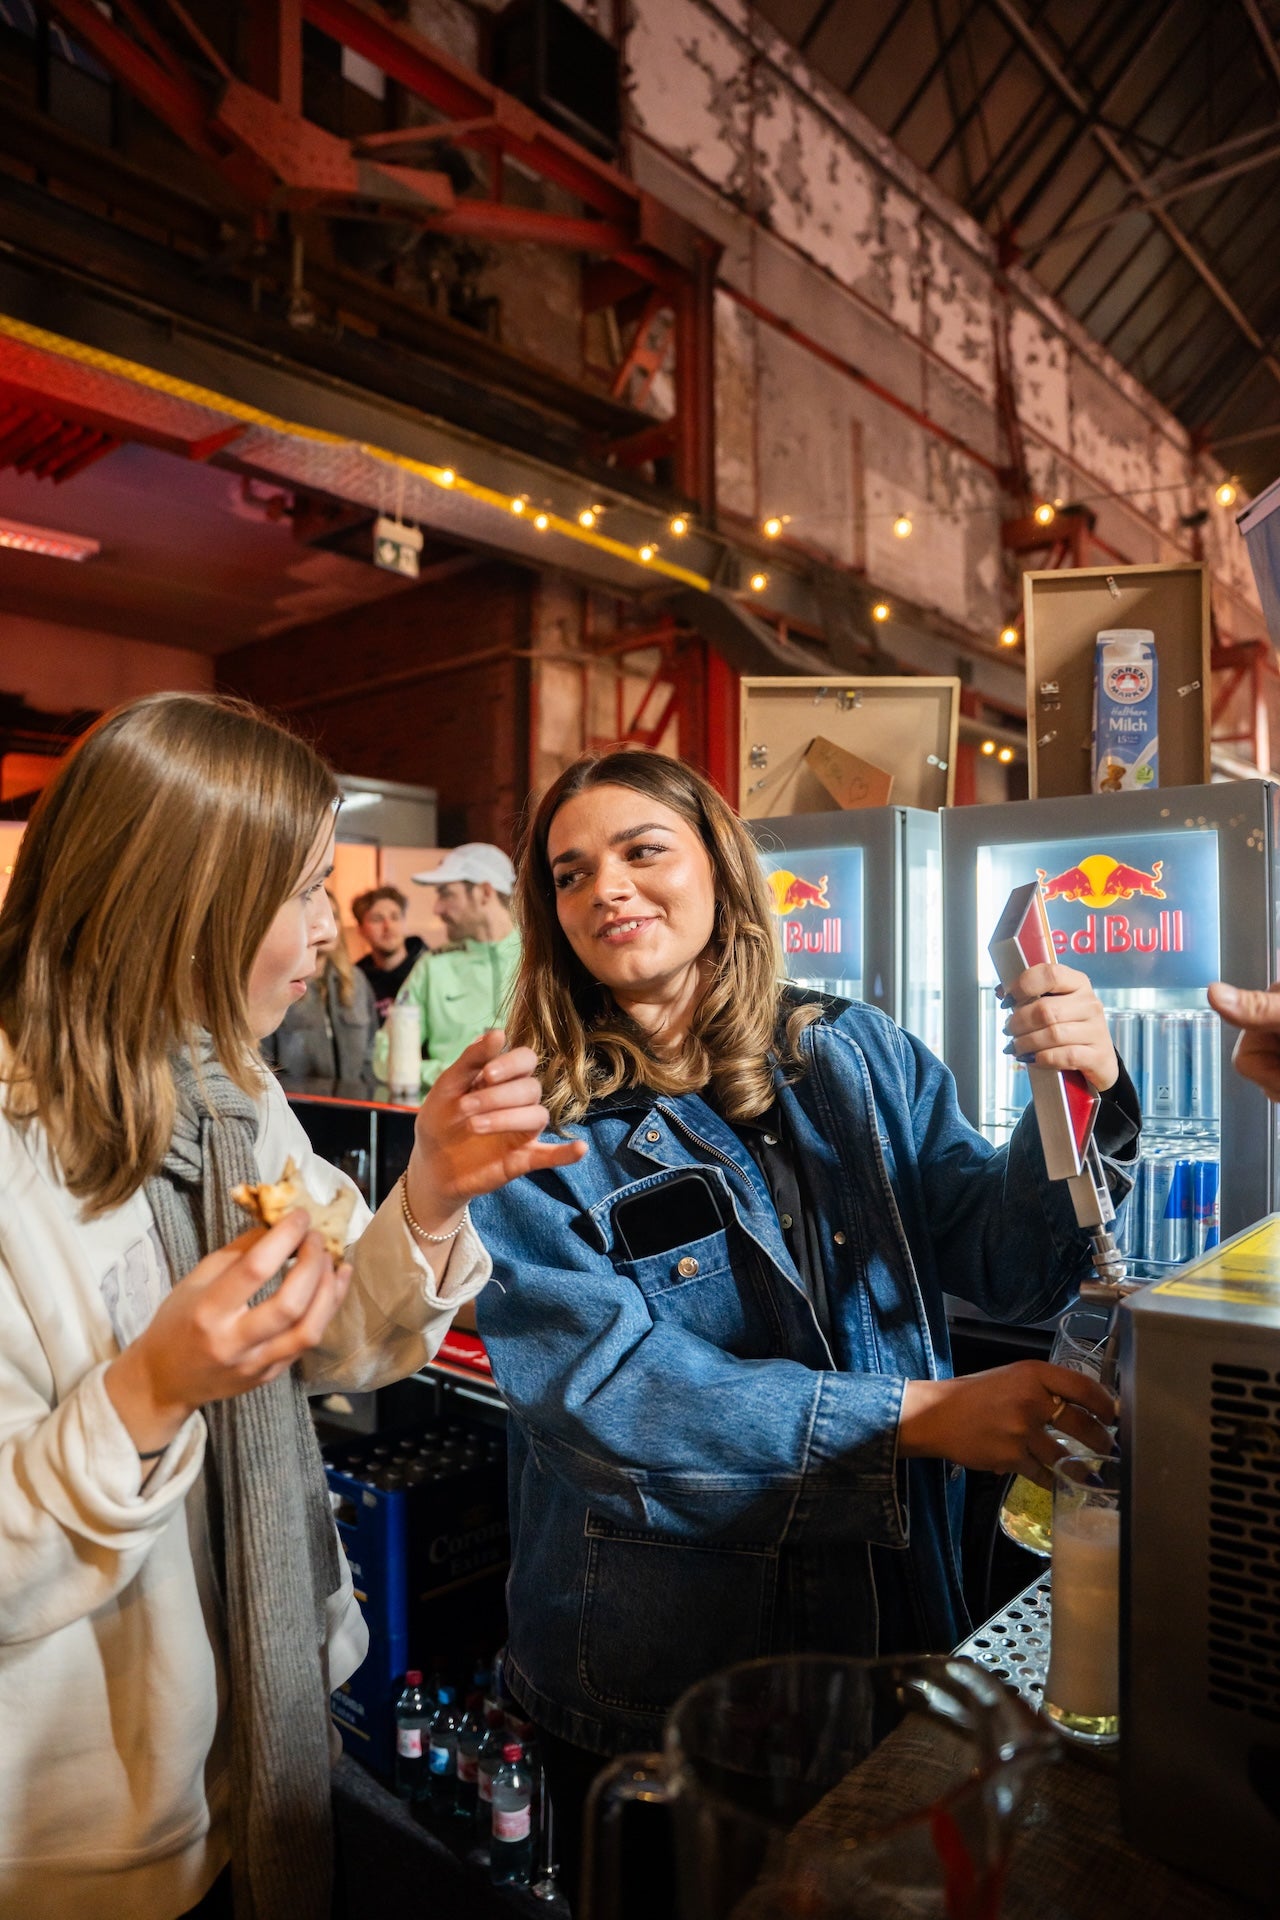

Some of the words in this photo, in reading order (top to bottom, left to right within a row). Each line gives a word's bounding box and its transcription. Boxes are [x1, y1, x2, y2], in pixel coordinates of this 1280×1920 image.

[1111, 685, 1145, 698] MARKE
[1109, 717, 1148, 732] Milch
[783, 917, 841, 954] Bull
[1051, 914, 1096, 954] ed
[1104, 910, 1184, 953] Bull
